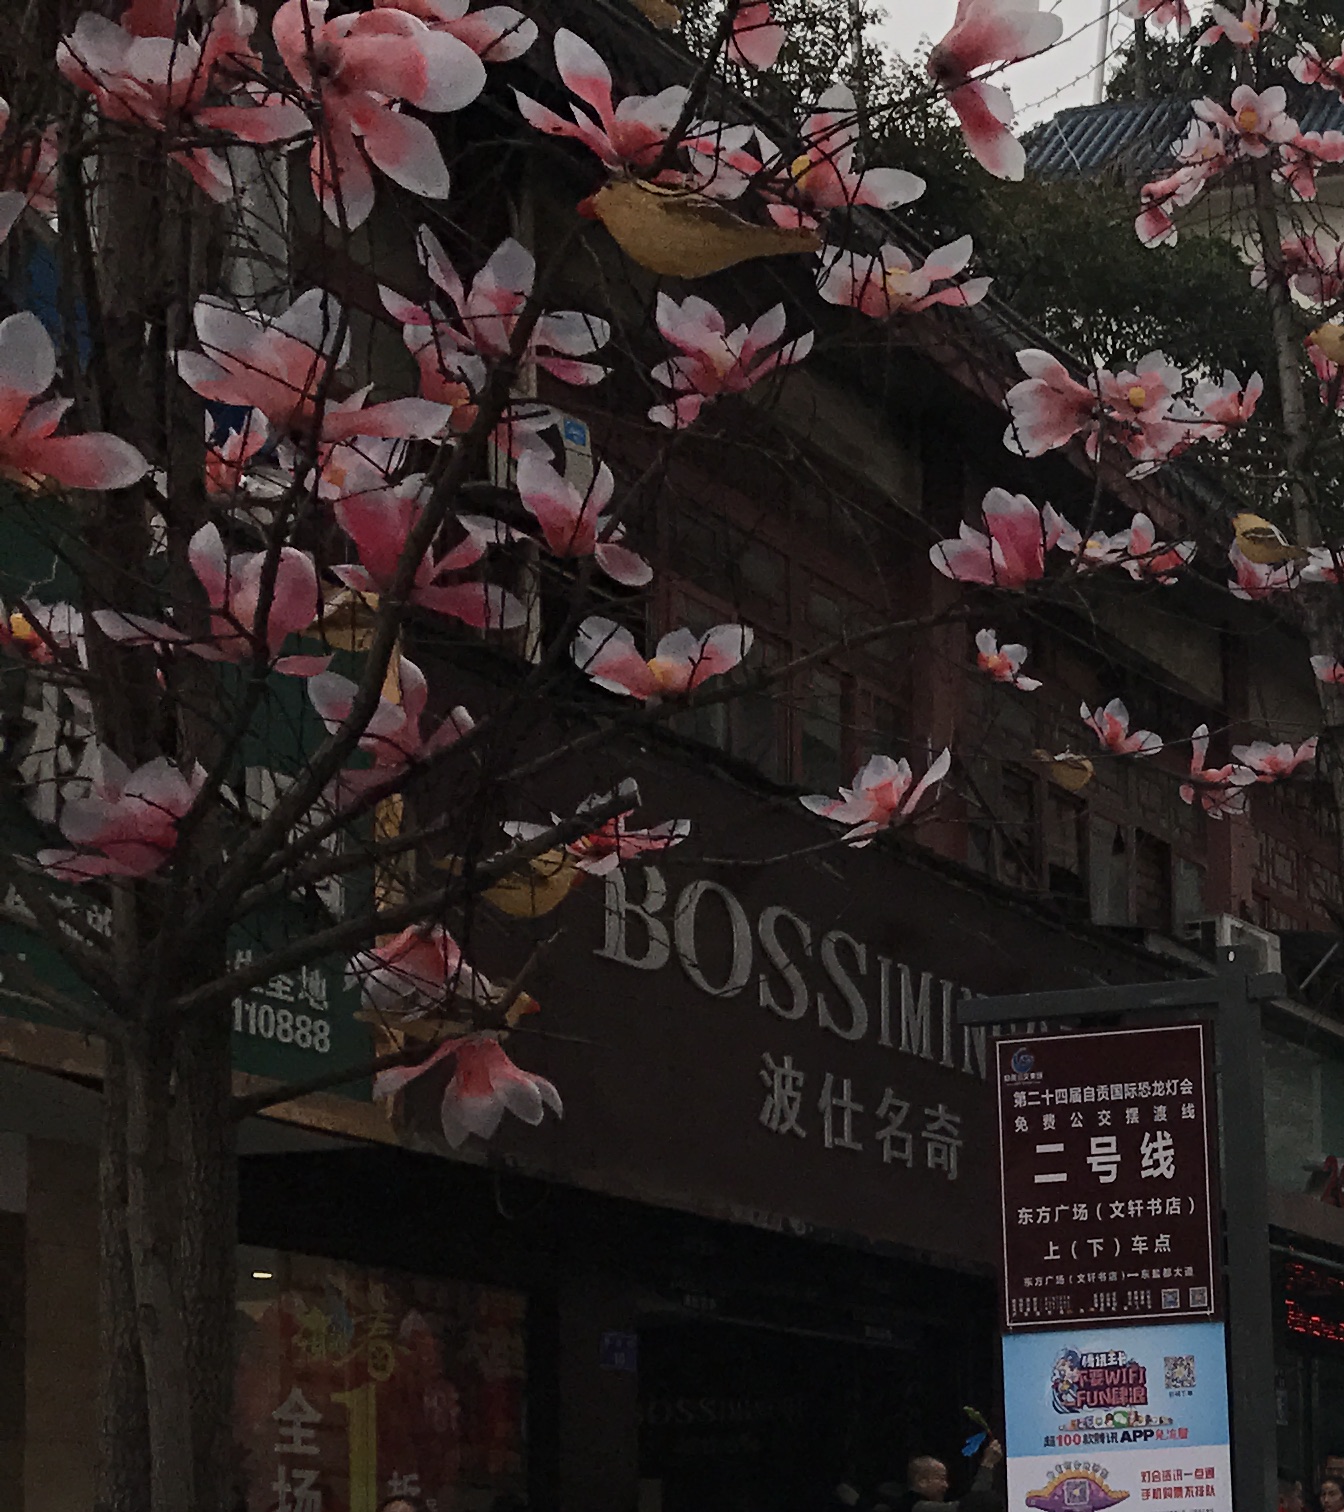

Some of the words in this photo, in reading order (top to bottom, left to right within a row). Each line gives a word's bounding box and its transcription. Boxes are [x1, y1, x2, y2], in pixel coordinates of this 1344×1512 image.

[1013, 1078, 1194, 1108] 第二十四届自贡国际恐龙灯会
[759, 1051, 965, 1180] 波仕名奇
[1014, 1103, 1196, 1133] 免费公交摆渡线
[1033, 1130, 1176, 1184] 二号线
